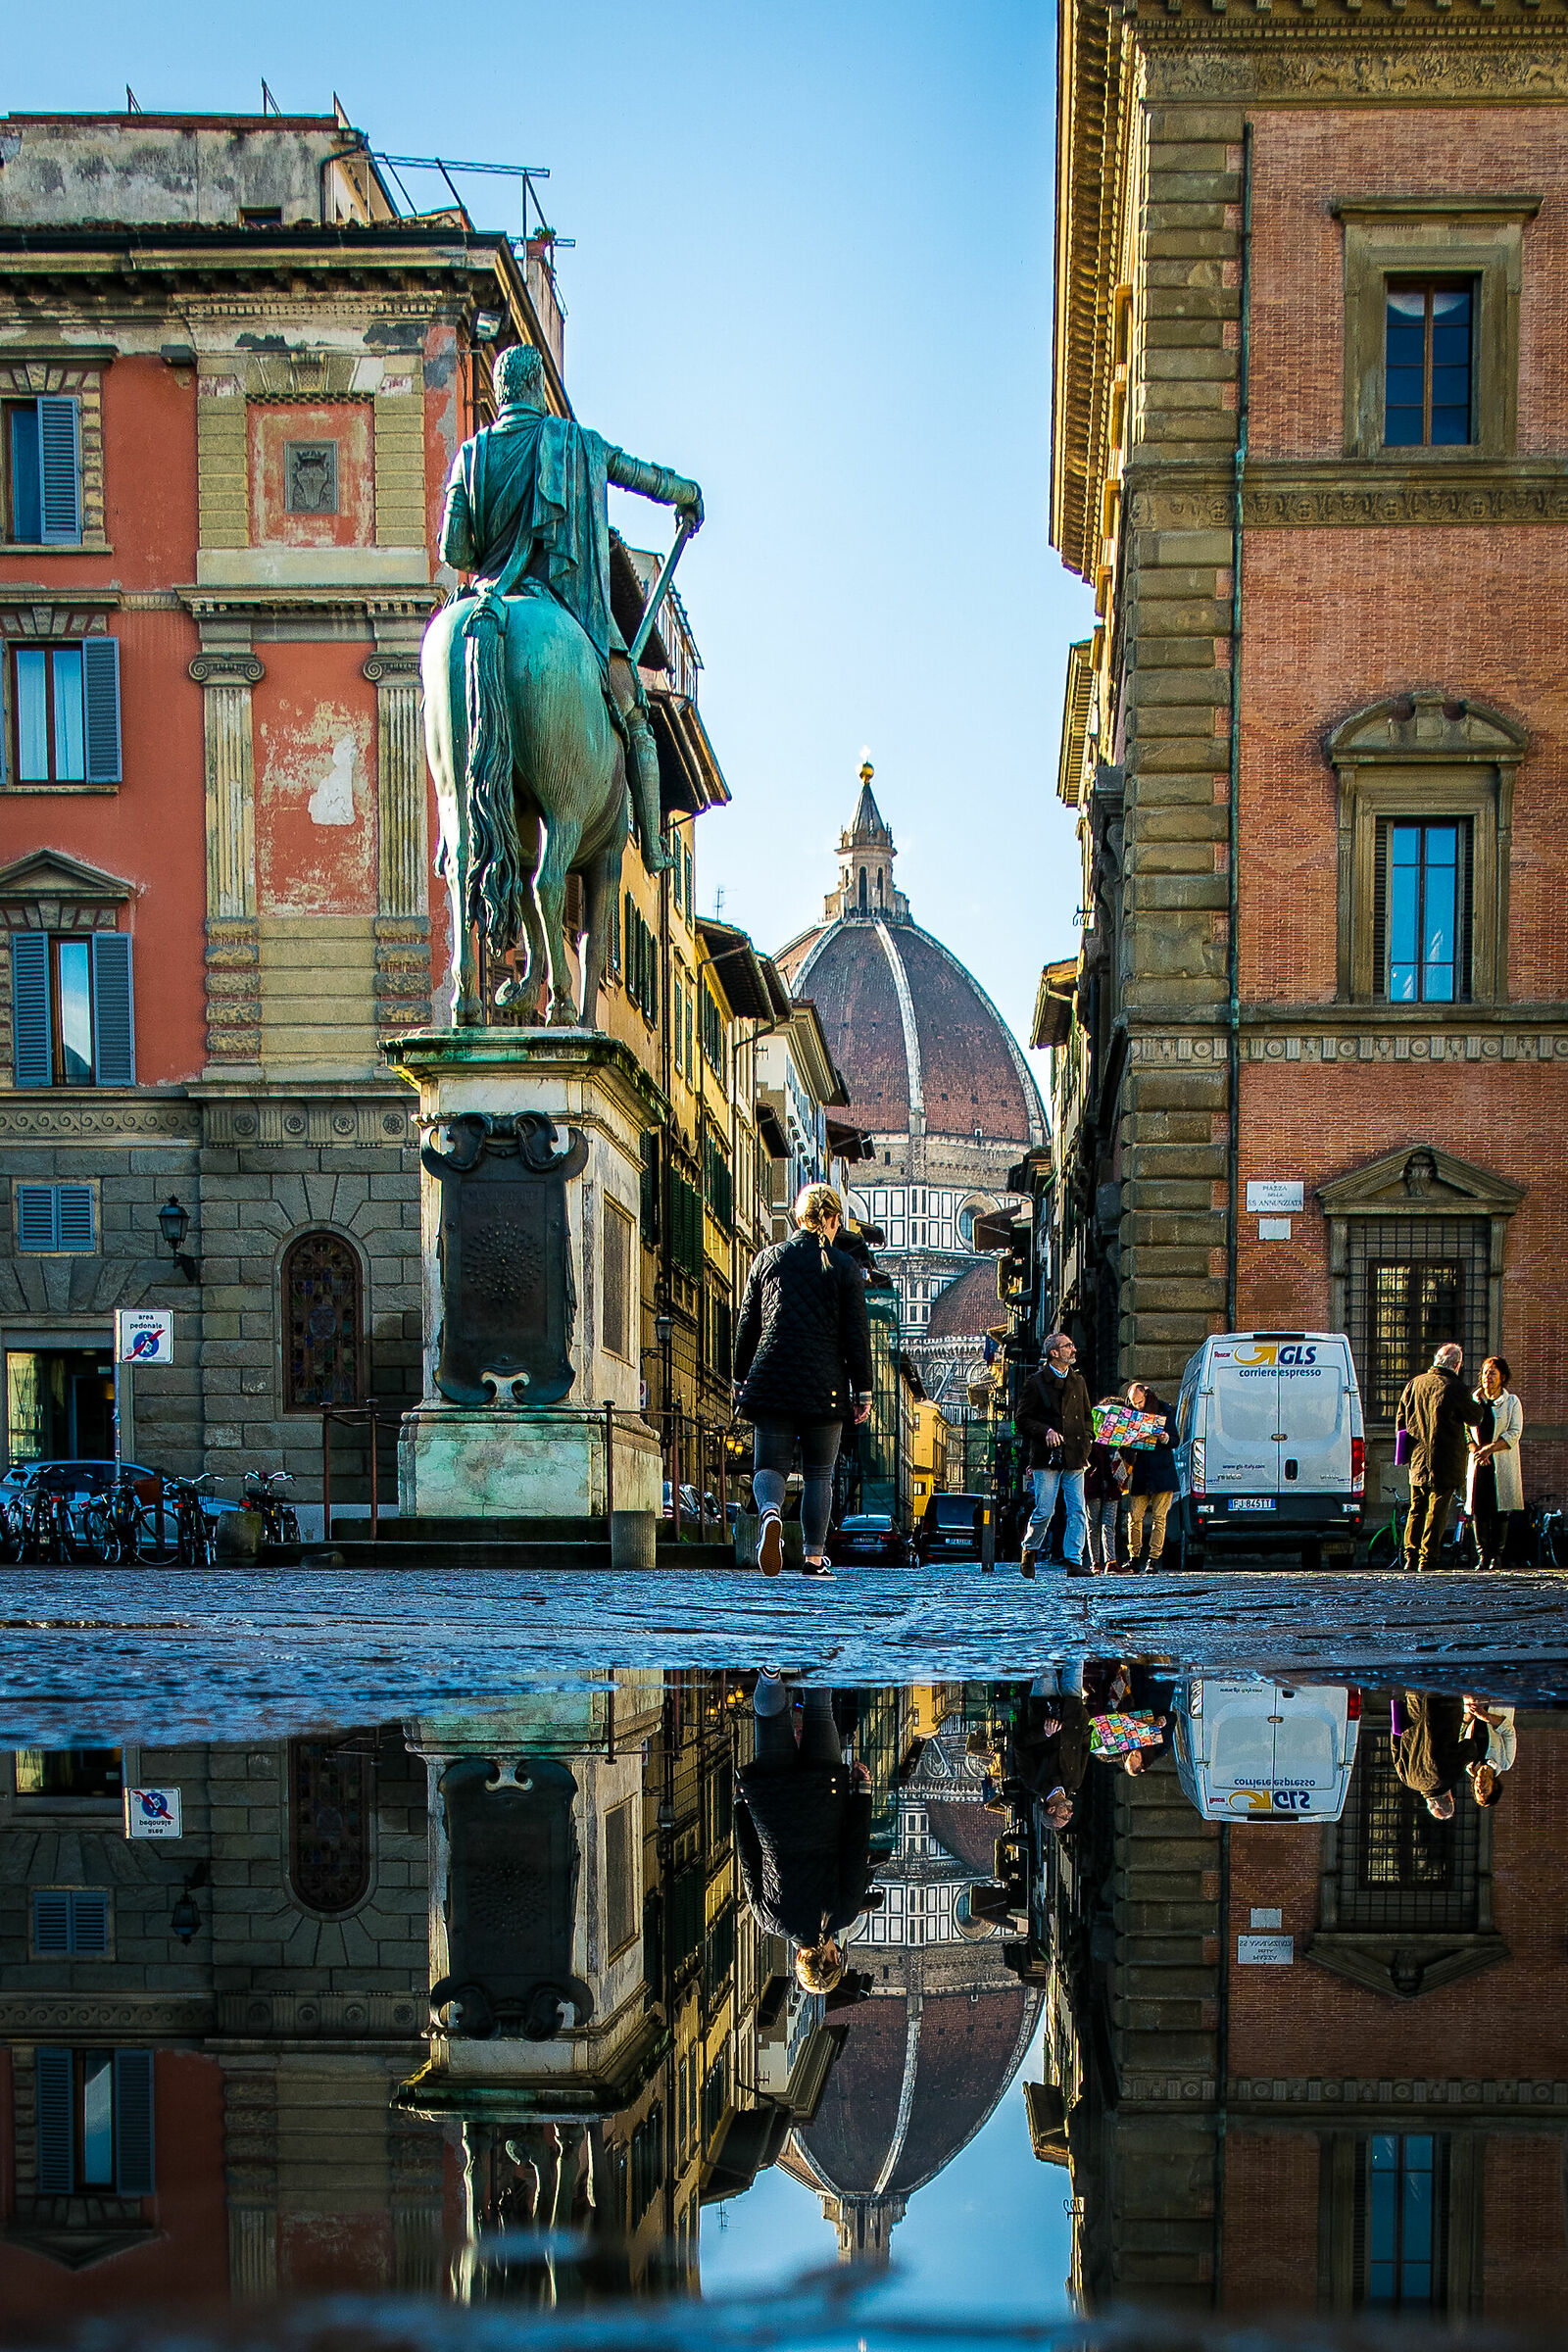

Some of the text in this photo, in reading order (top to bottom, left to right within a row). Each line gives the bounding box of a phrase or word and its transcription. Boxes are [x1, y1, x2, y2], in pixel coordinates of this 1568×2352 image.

[1279, 1345, 1317, 1365] GLS
[1239, 1367, 1322, 1379] corriere espresso
